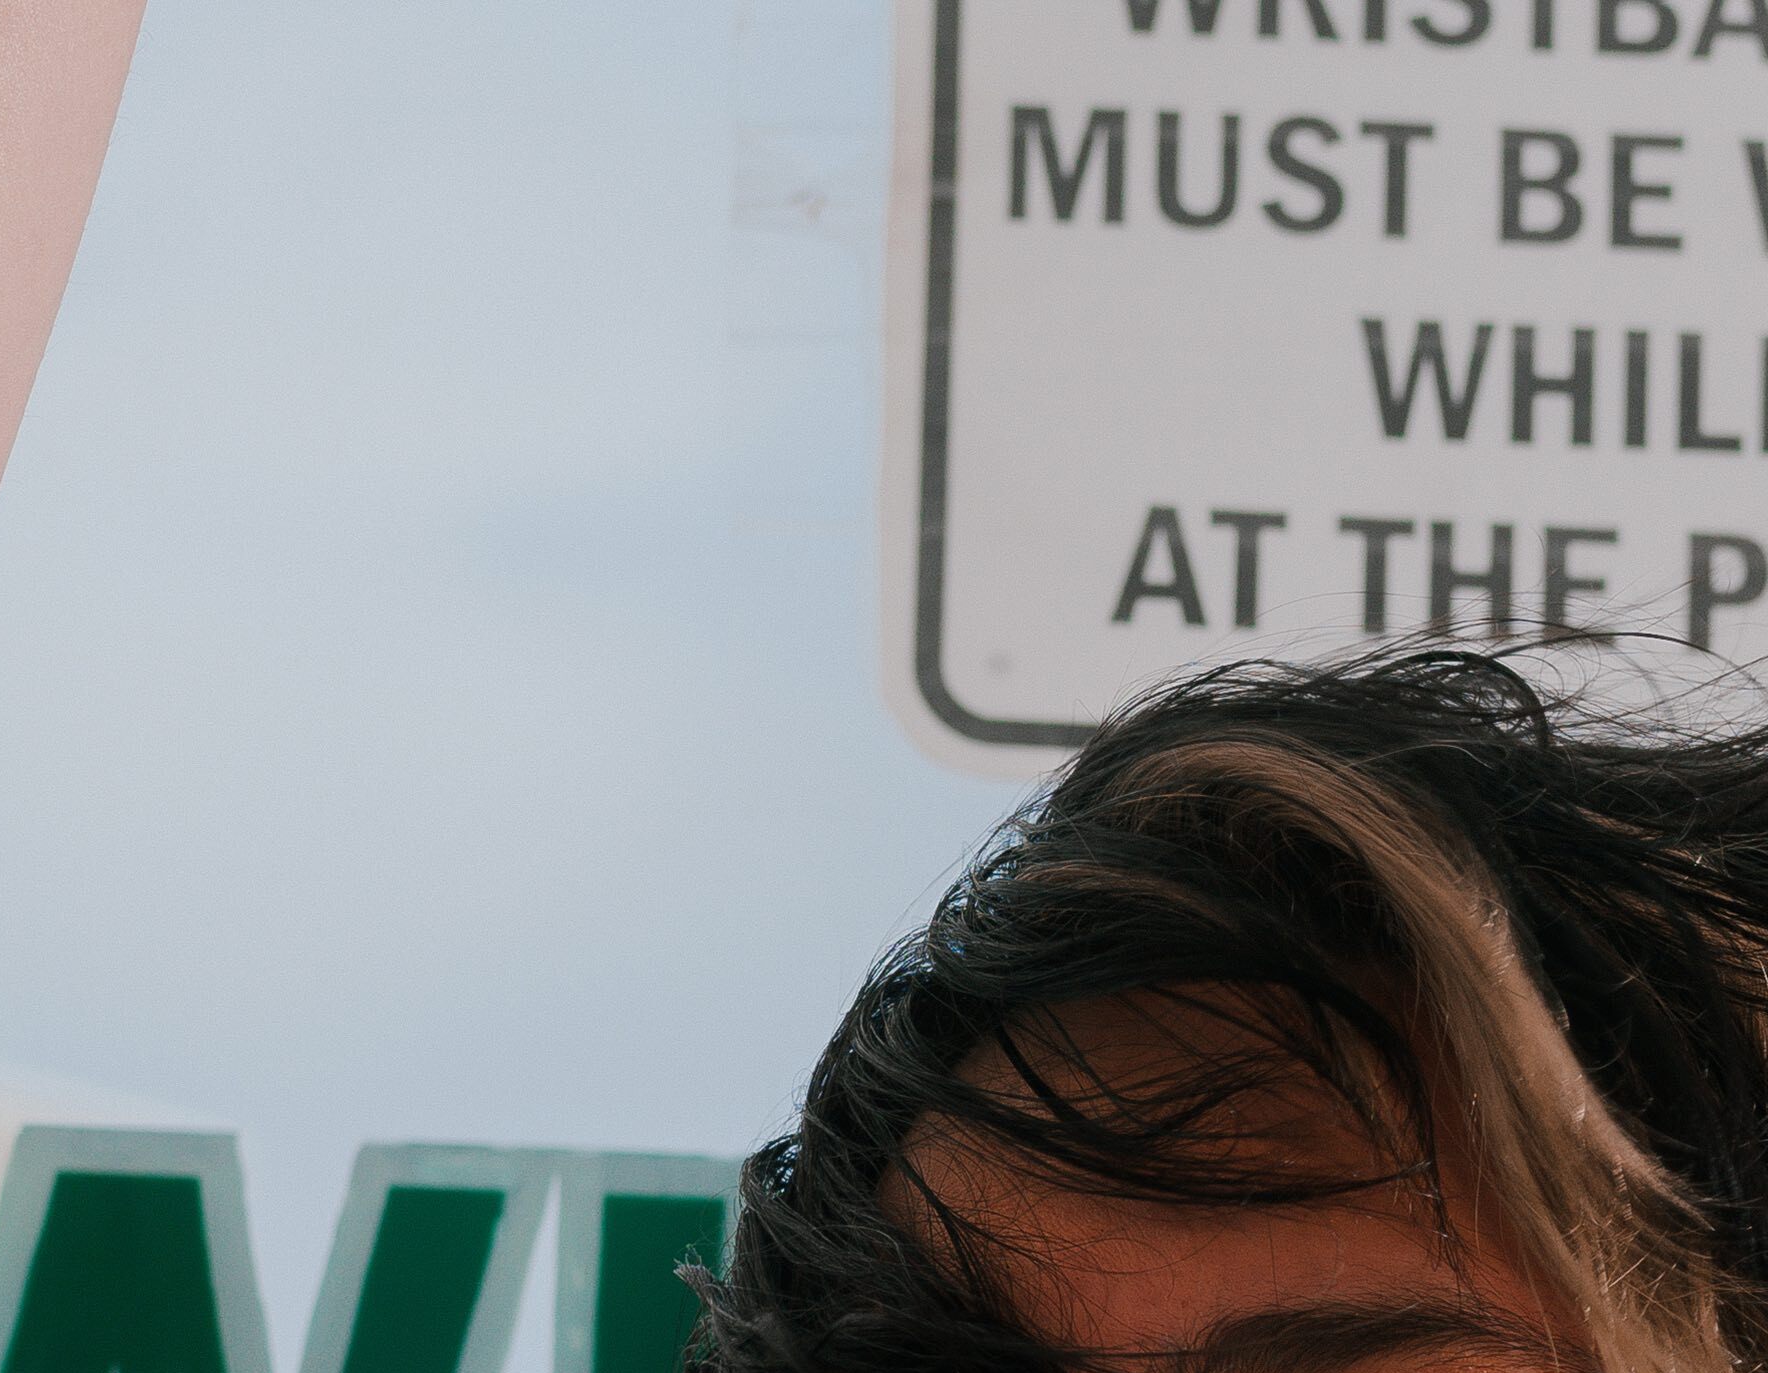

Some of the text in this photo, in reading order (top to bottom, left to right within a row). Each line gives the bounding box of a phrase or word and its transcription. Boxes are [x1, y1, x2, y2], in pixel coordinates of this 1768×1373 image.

[1006, 103, 1436, 239] MUST
[1498, 127, 1686, 253] BE
[1109, 504, 1289, 631] AT
[1336, 514, 1620, 645] THE
